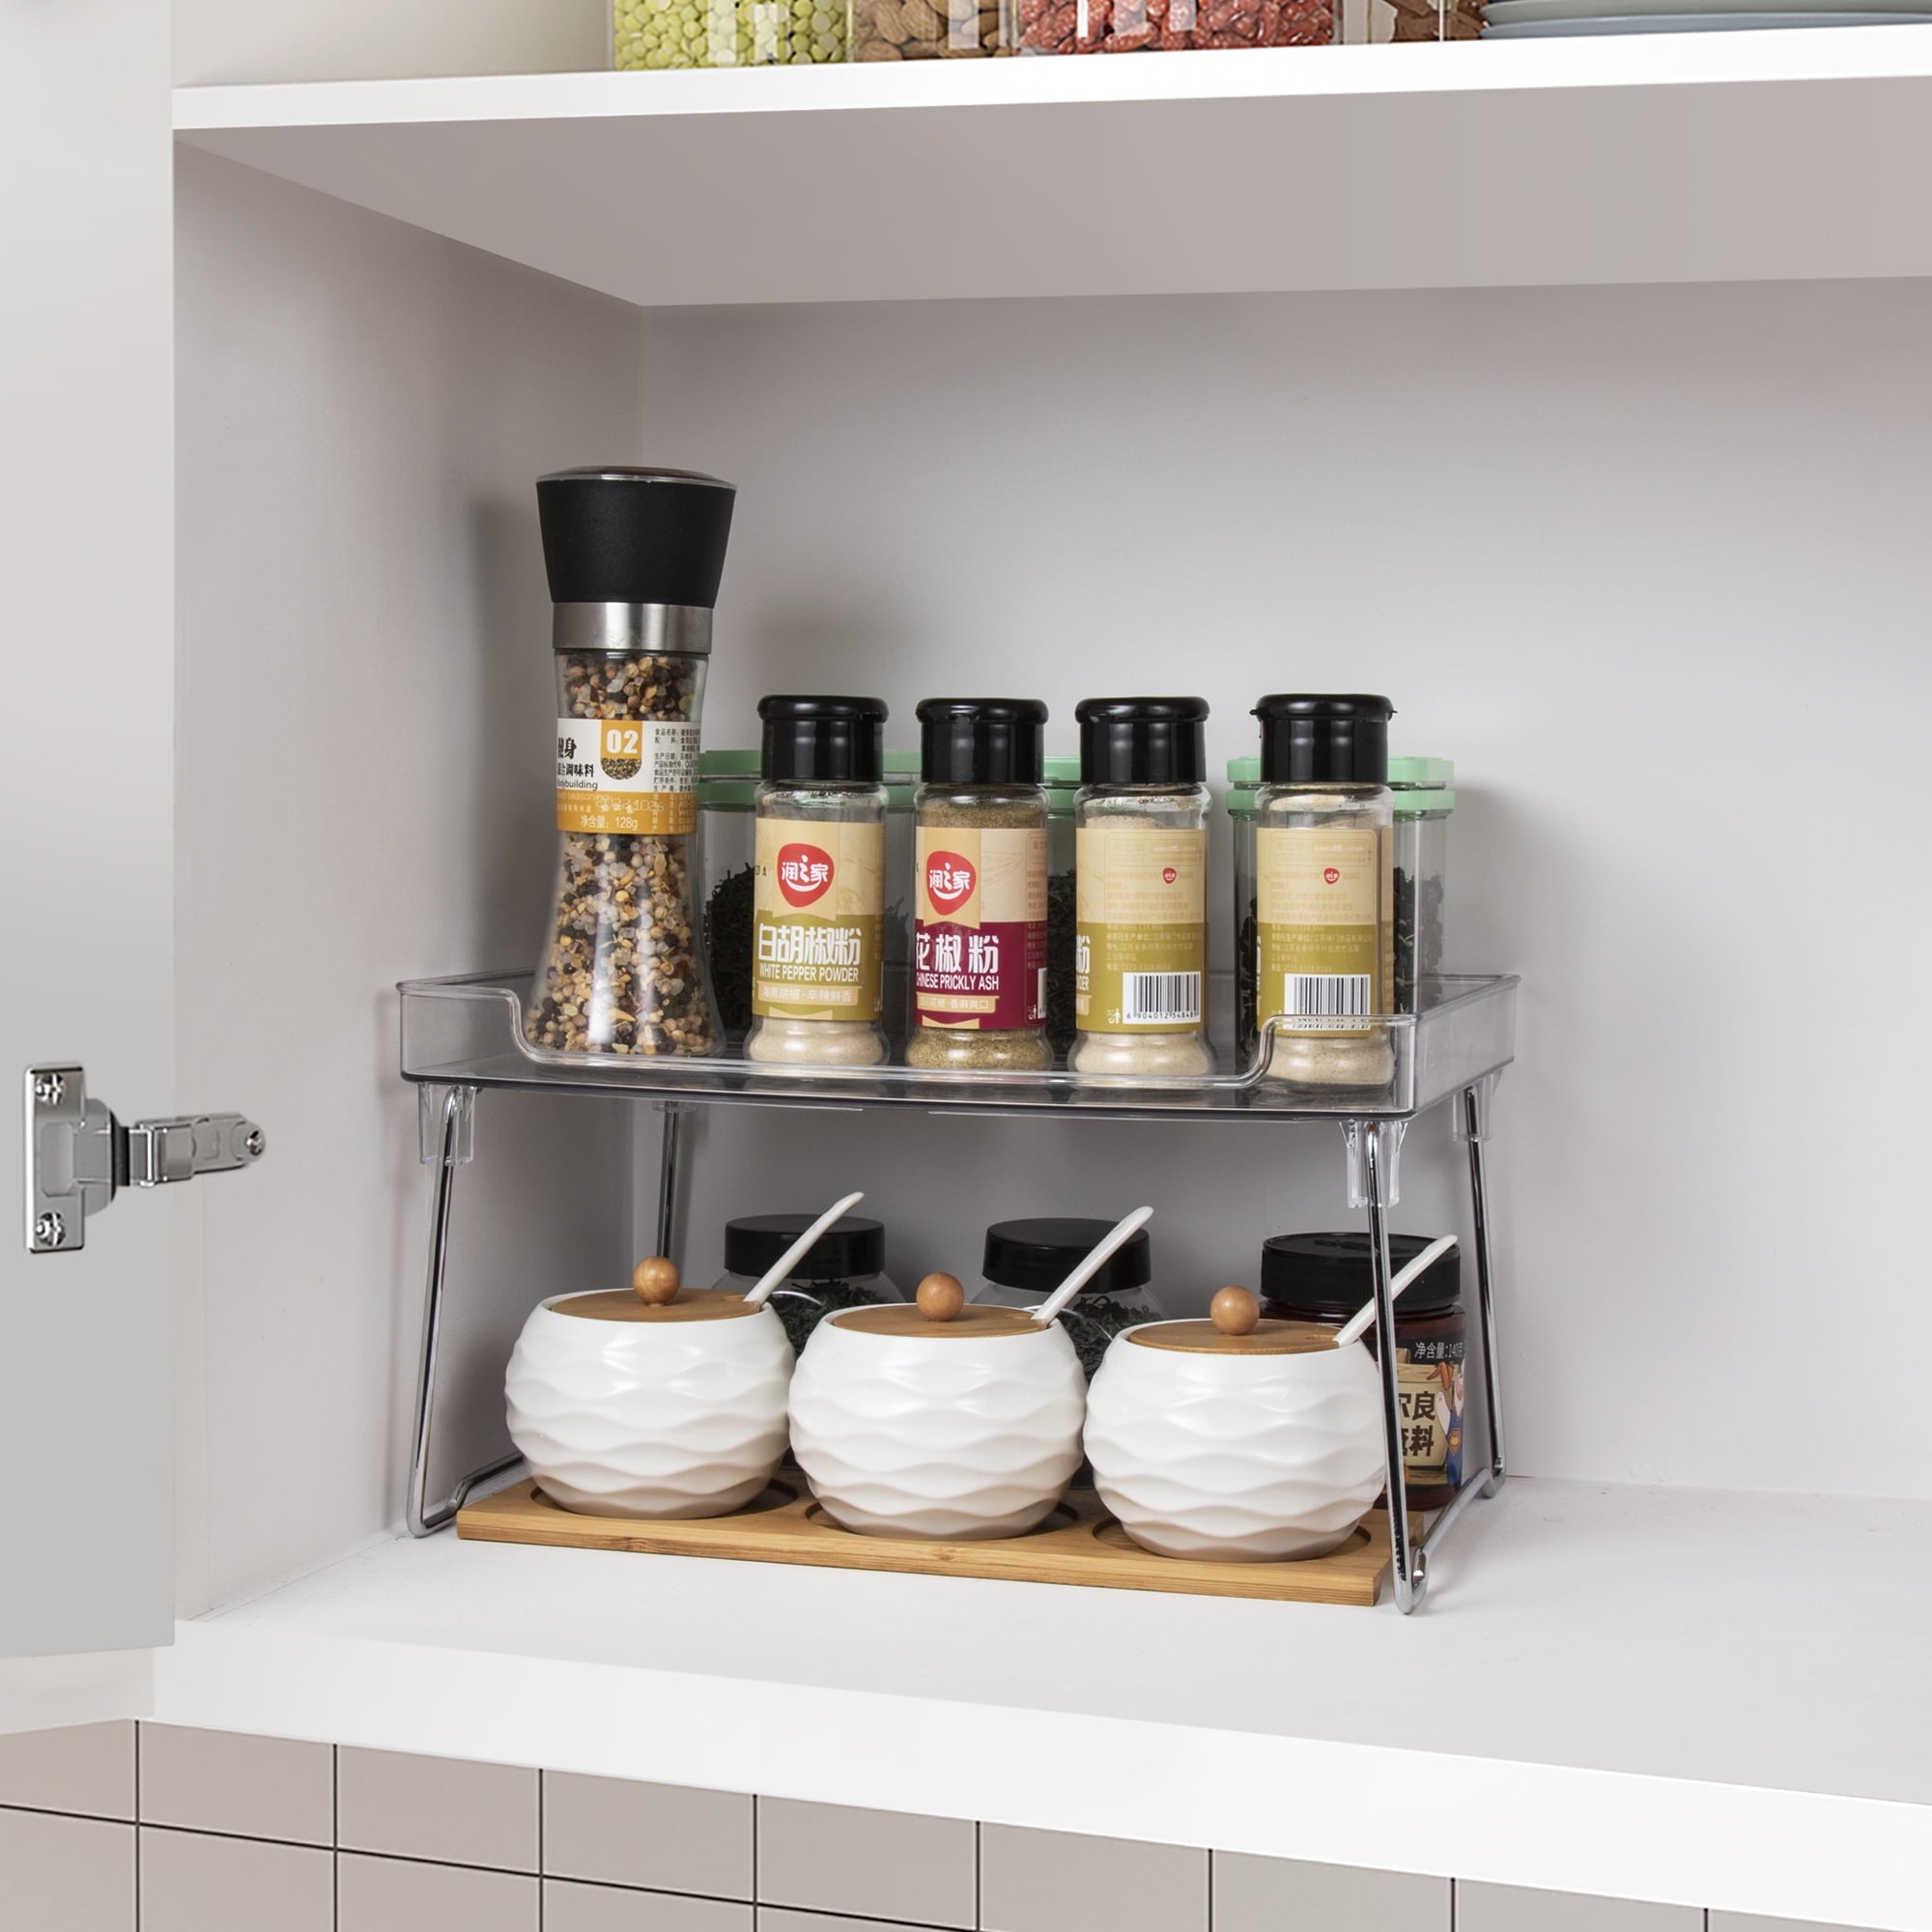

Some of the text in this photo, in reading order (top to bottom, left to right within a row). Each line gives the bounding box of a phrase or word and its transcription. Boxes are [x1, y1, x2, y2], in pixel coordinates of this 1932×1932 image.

[607, 729, 639, 754] 02
[781, 854, 829, 883] 润之家
[928, 862, 971, 890] 润之家
[758, 923, 862, 966] 白胡椒粉
[916, 932, 1000, 974] 花椒粉
[759, 962, 859, 982] WHITE PEPPER POWDER
[940, 974, 977, 990] PRICKLY
[978, 975, 1000, 991] ASH
